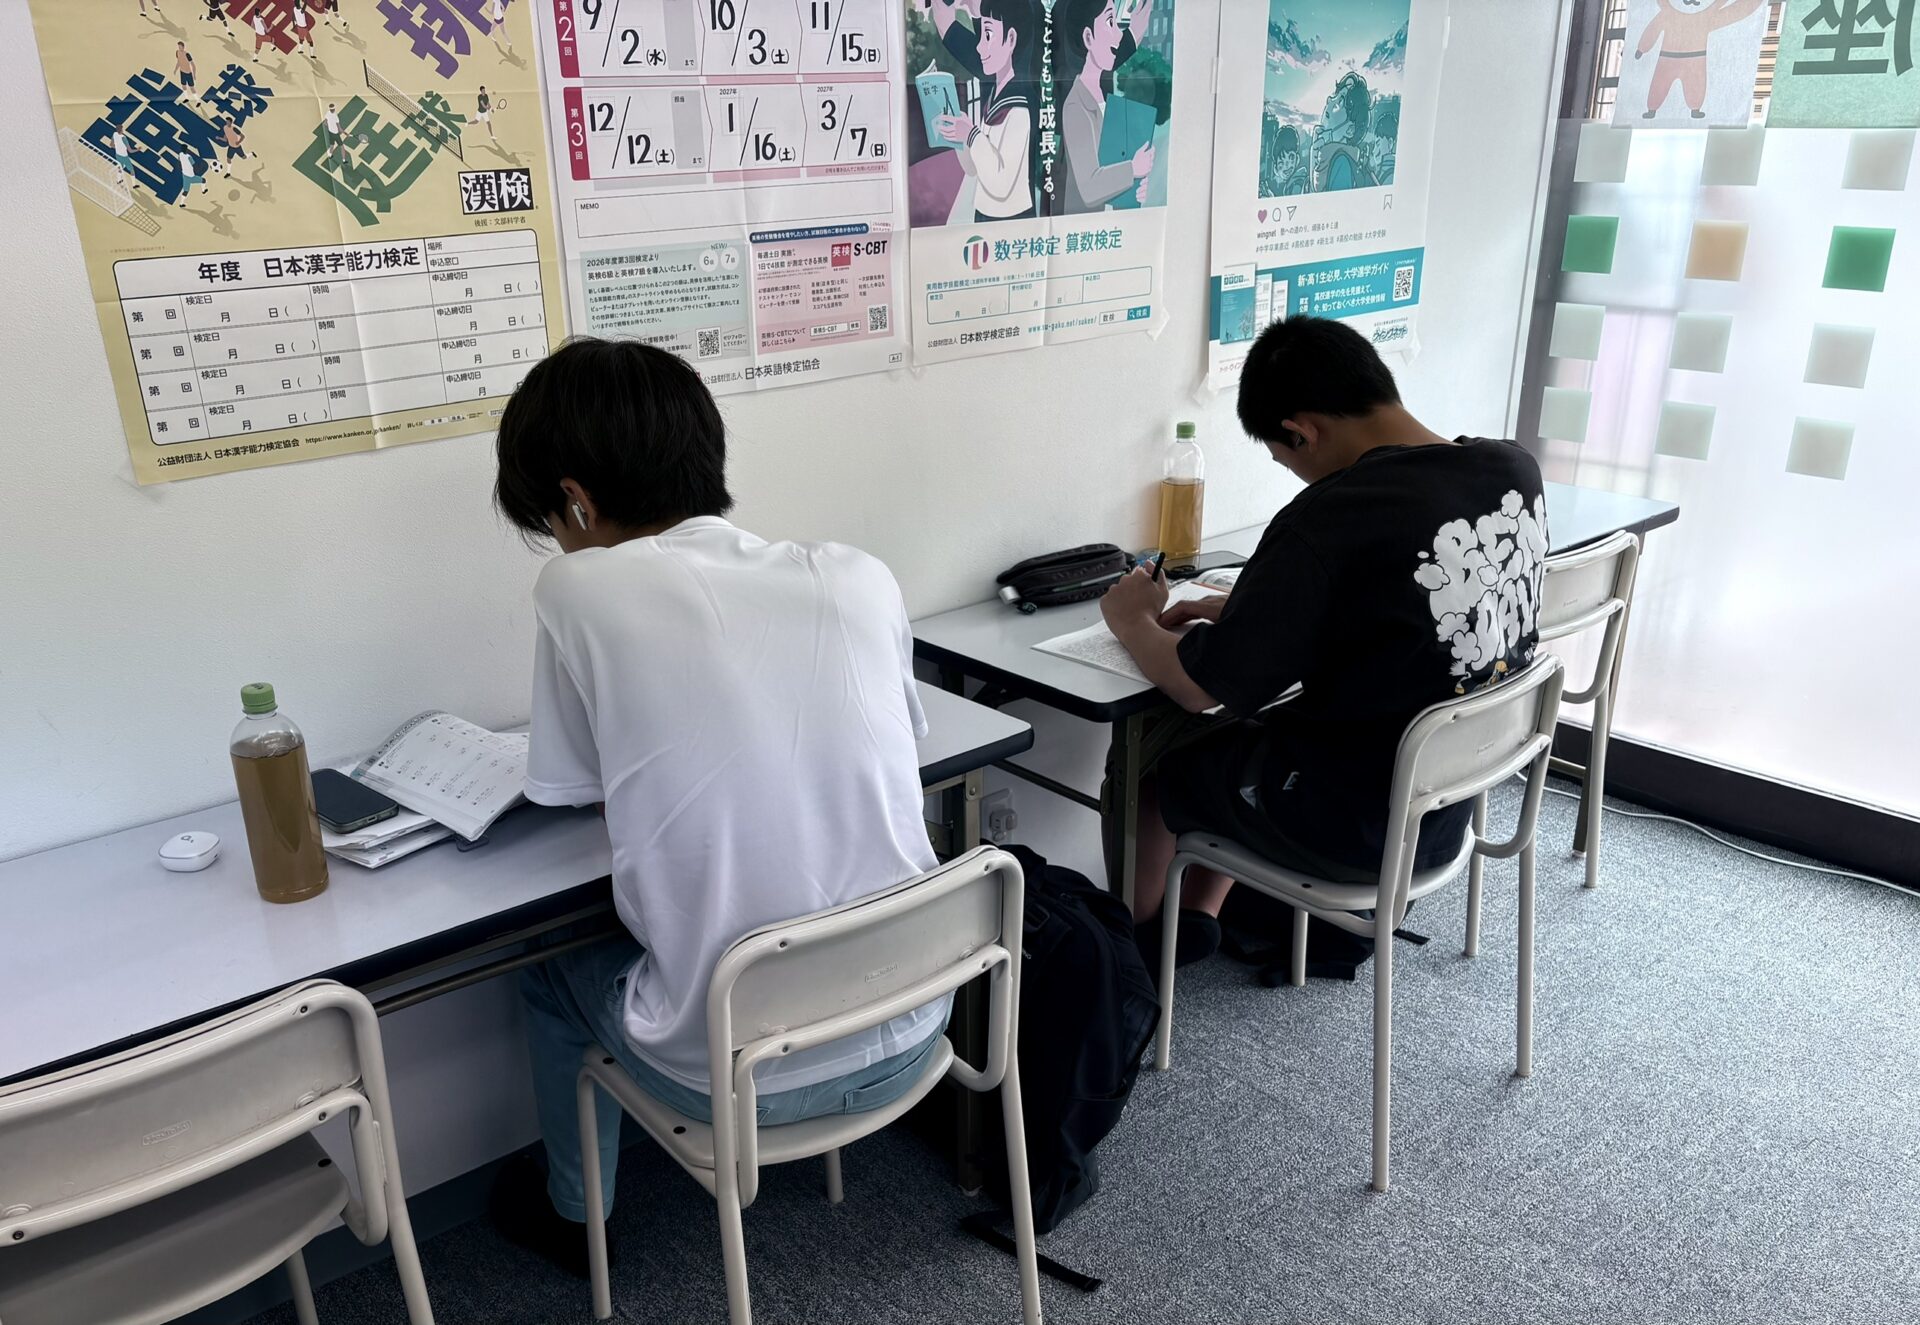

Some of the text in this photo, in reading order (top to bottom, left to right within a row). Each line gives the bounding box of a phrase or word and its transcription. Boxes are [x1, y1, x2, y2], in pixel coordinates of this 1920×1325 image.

[684, 58, 695, 66] まで
[719, 88, 737, 96] 2027年
[816, 86, 833, 94] 2027年
[460, 169, 533, 214] 漢検
[427, 241, 442, 251] 場所
[831, 240, 888, 258] 英検 S-CBT
[994, 228, 1122, 262] 数学検定 算数検定
[198, 246, 421, 283] 年度 日本漢字能力検定
[429, 256, 459, 267] 申込窓口
[586, 253, 659, 267] 2026年度第3回検定より
[432, 271, 468, 282] 申込締切日
[312, 285, 330, 294] 時間
[465, 287, 473, 298] 月
[185, 294, 213, 305] 検定日
[131, 308, 177, 323] 第 回
[436, 305, 473, 316] 申込締切日
[220, 311, 231, 323] 月
[318, 320, 336, 331] 時間
[469, 321, 478, 331] 月
[193, 332, 221, 344] 検定日
[960, 326, 1020, 344] 日本数学検定協会
[441, 338, 477, 350] 申込締切日
[140, 345, 185, 360] 第 回
[228, 348, 238, 360] 月
[474, 353, 482, 364] 月
[324, 355, 341, 365] 時間
[201, 368, 228, 380] 検定日
[745, 358, 820, 380] 日本英語検定協会
[446, 371, 482, 383] 申込締切日
[148, 382, 192, 397] 第 回
[235, 384, 245, 395] 月
[329, 389, 347, 400] 時間
[478, 386, 487, 397] 月
[208, 404, 235, 416] 検定日
[156, 417, 200, 433] 第 回
[242, 420, 252, 431] 月
[157, 451, 212, 468] 公益財団法人
[214, 437, 300, 459] 日本漢字能力検定協会
